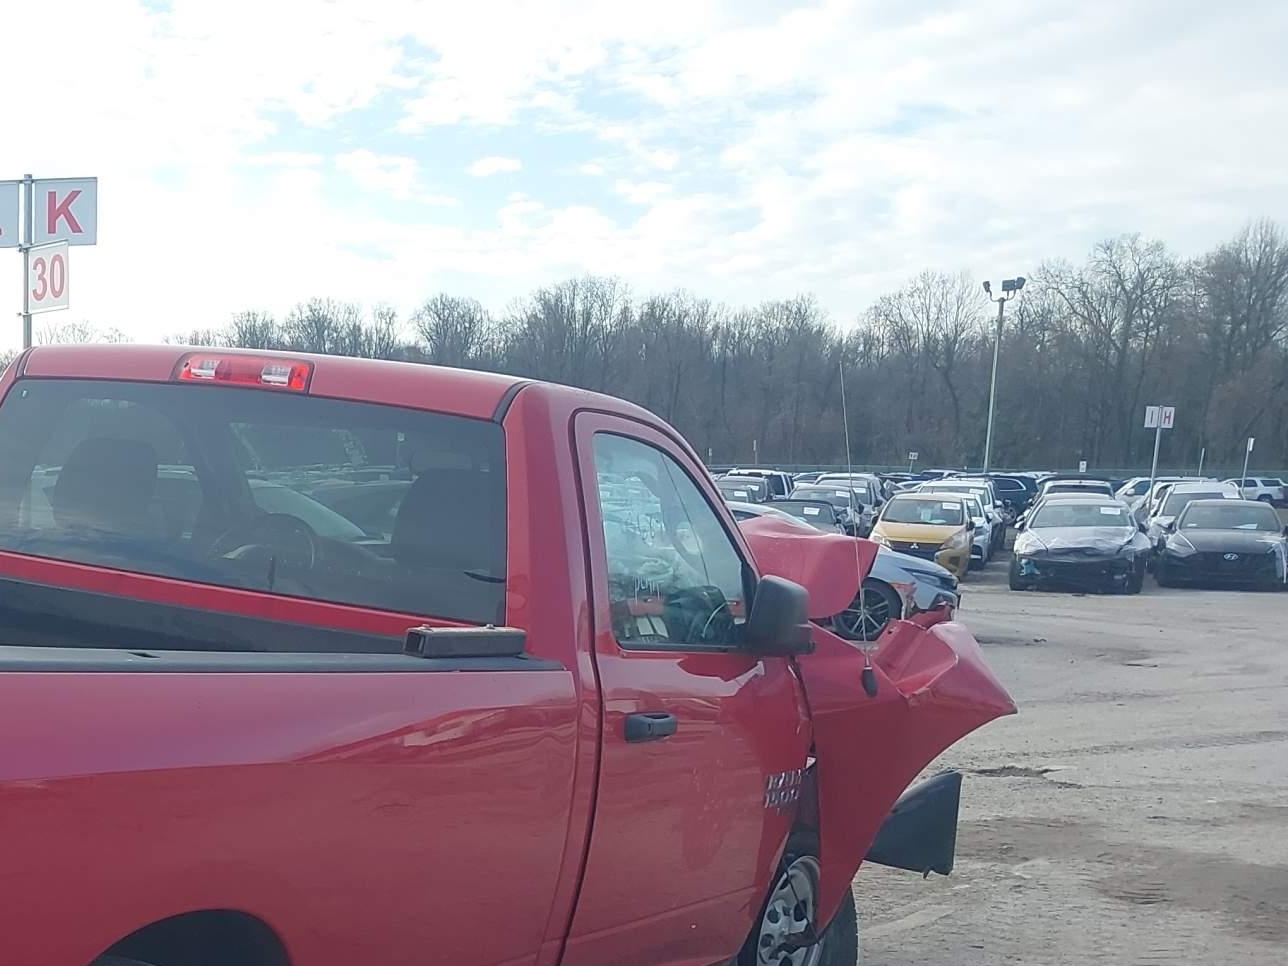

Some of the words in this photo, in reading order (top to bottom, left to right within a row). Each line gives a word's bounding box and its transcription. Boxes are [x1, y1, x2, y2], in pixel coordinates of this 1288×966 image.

[48, 190, 83, 234] K
[32, 254, 64, 301] 30
[1163, 410, 1172, 425] H
